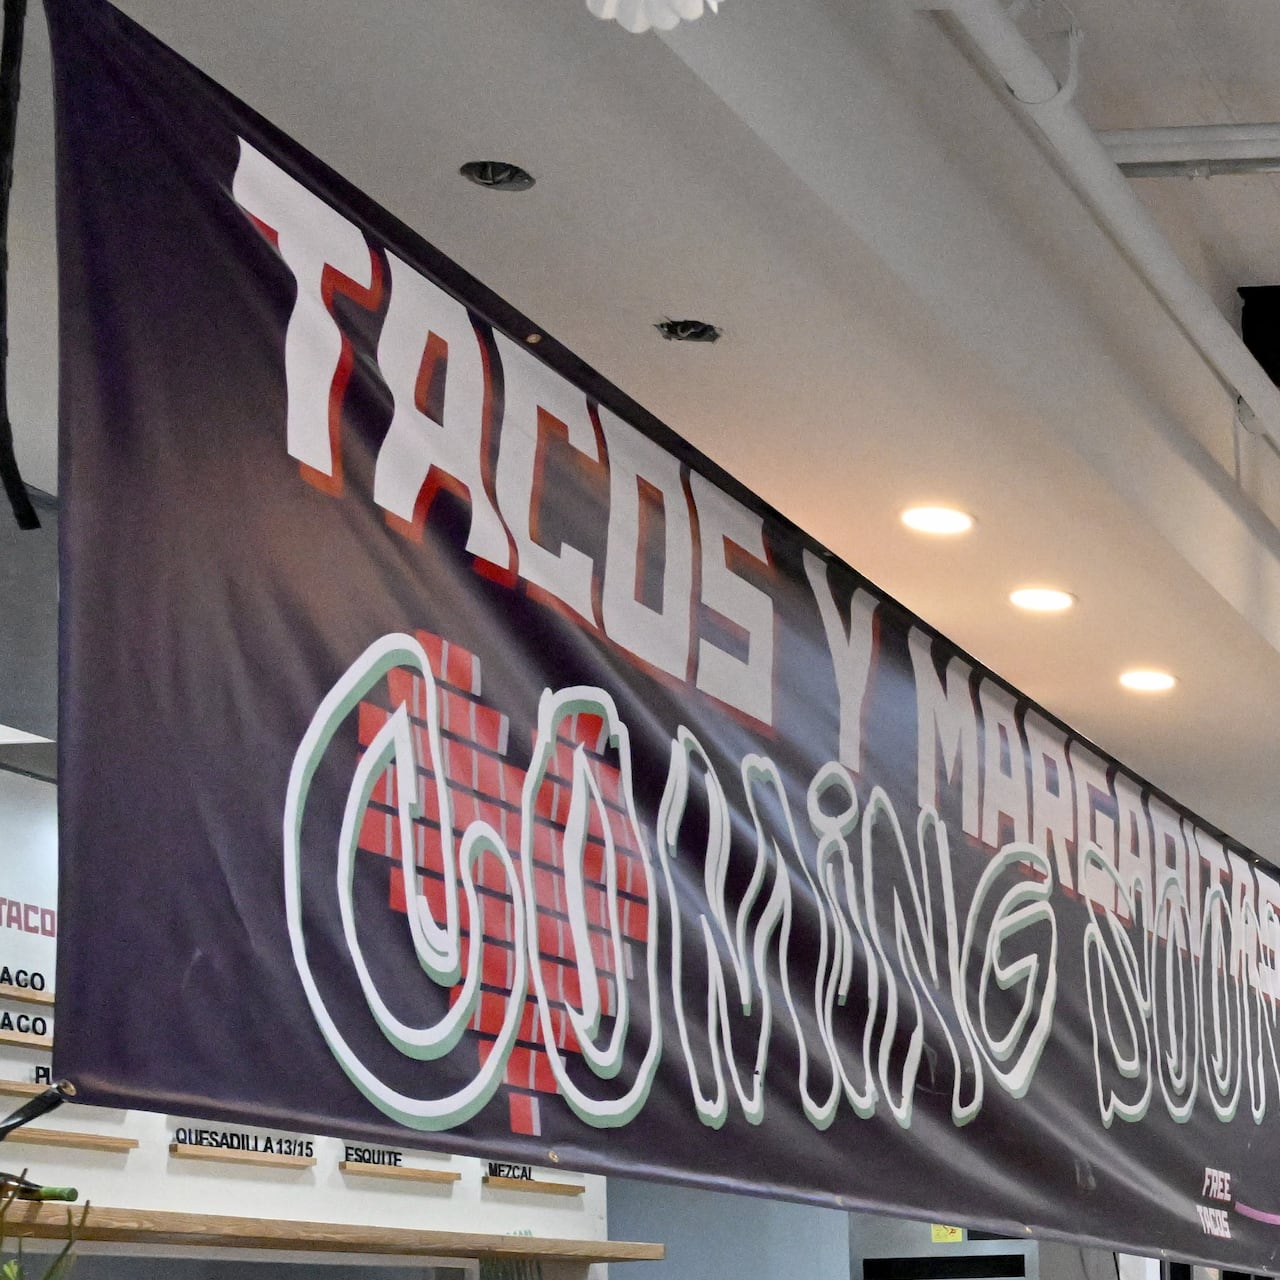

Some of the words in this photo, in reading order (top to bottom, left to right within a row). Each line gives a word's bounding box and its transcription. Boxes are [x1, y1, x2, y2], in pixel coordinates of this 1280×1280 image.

[233, 135, 777, 736] TACOS
[803, 548, 880, 773] Y
[0, 966, 45, 991] ACO
[0, 1011, 47, 1036] ACO
[175, 1127, 275, 1154] QUESADILLA
[276, 1138, 314, 1158] 13/15
[344, 1145, 403, 1168] ESQUITE
[487, 1162, 535, 1182] MEZCAL
[1202, 1167, 1232, 1202] FREE
[1196, 1204, 1232, 1239] TACOS
